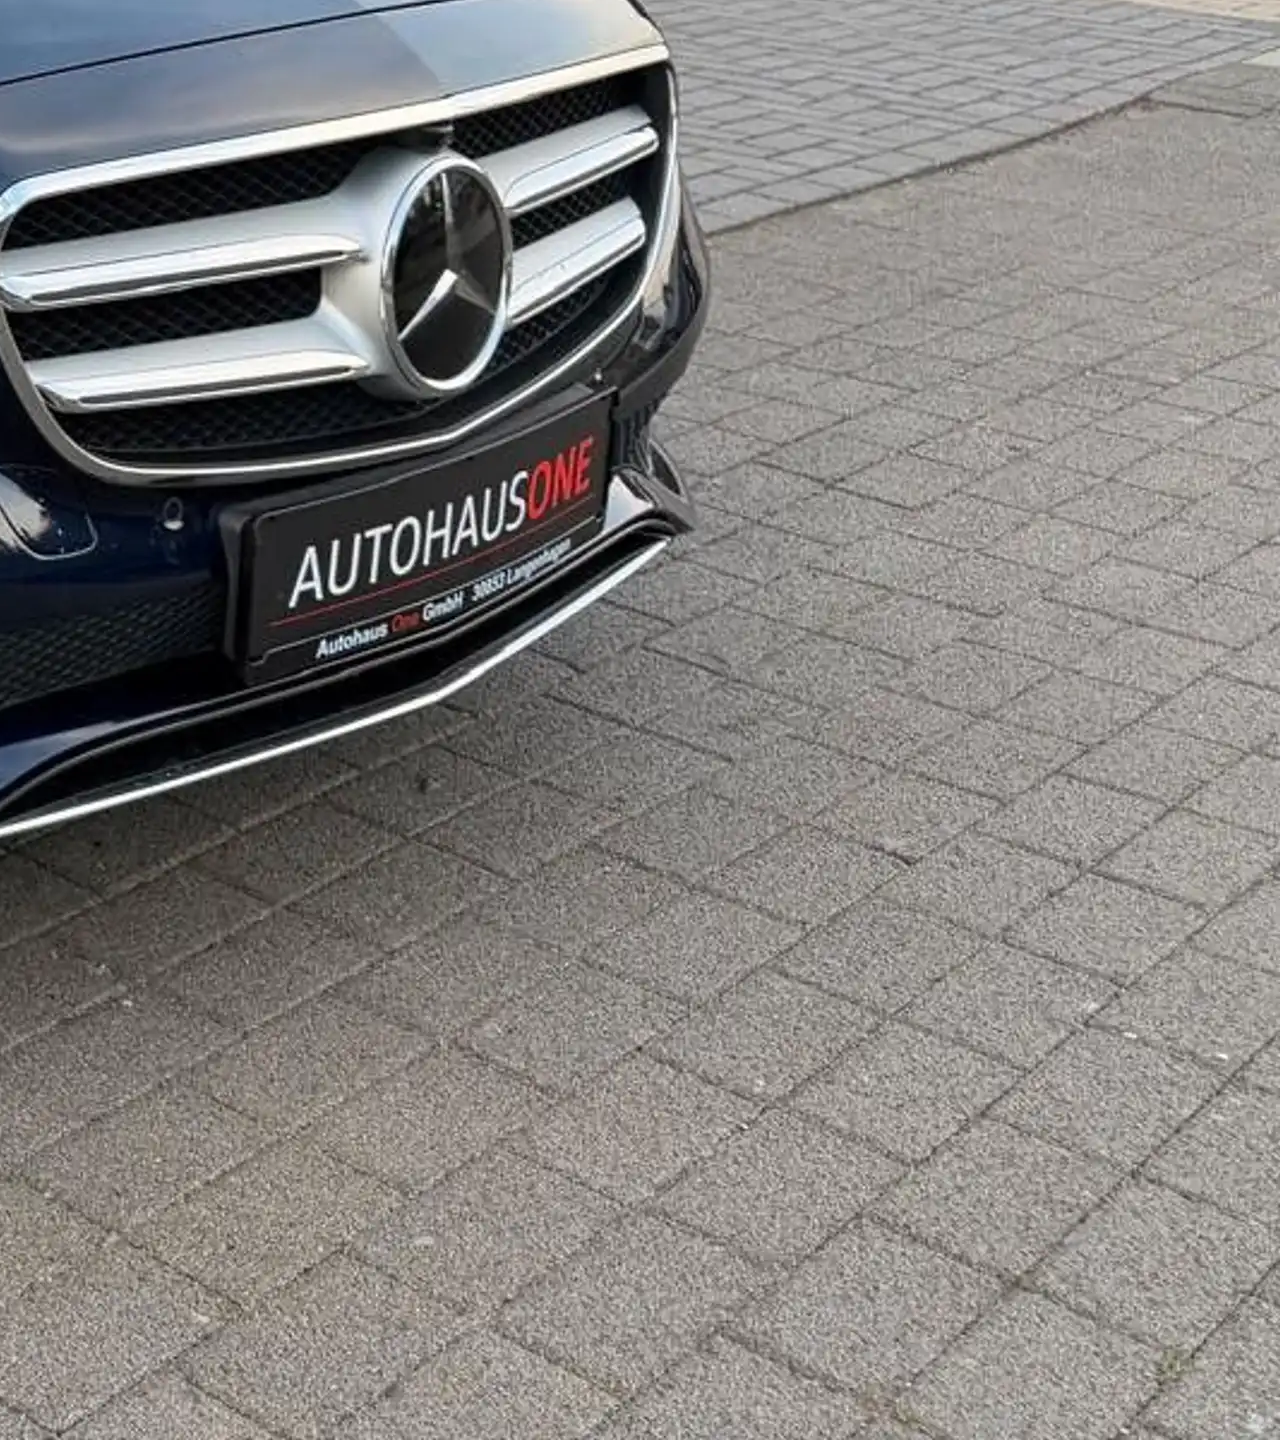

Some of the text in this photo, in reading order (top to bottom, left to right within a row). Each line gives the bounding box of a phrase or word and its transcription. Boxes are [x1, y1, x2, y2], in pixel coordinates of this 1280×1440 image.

[315, 623, 389, 659] Autohaus
[391, 612, 421, 633] One
[422, 590, 464, 622] GmbH
